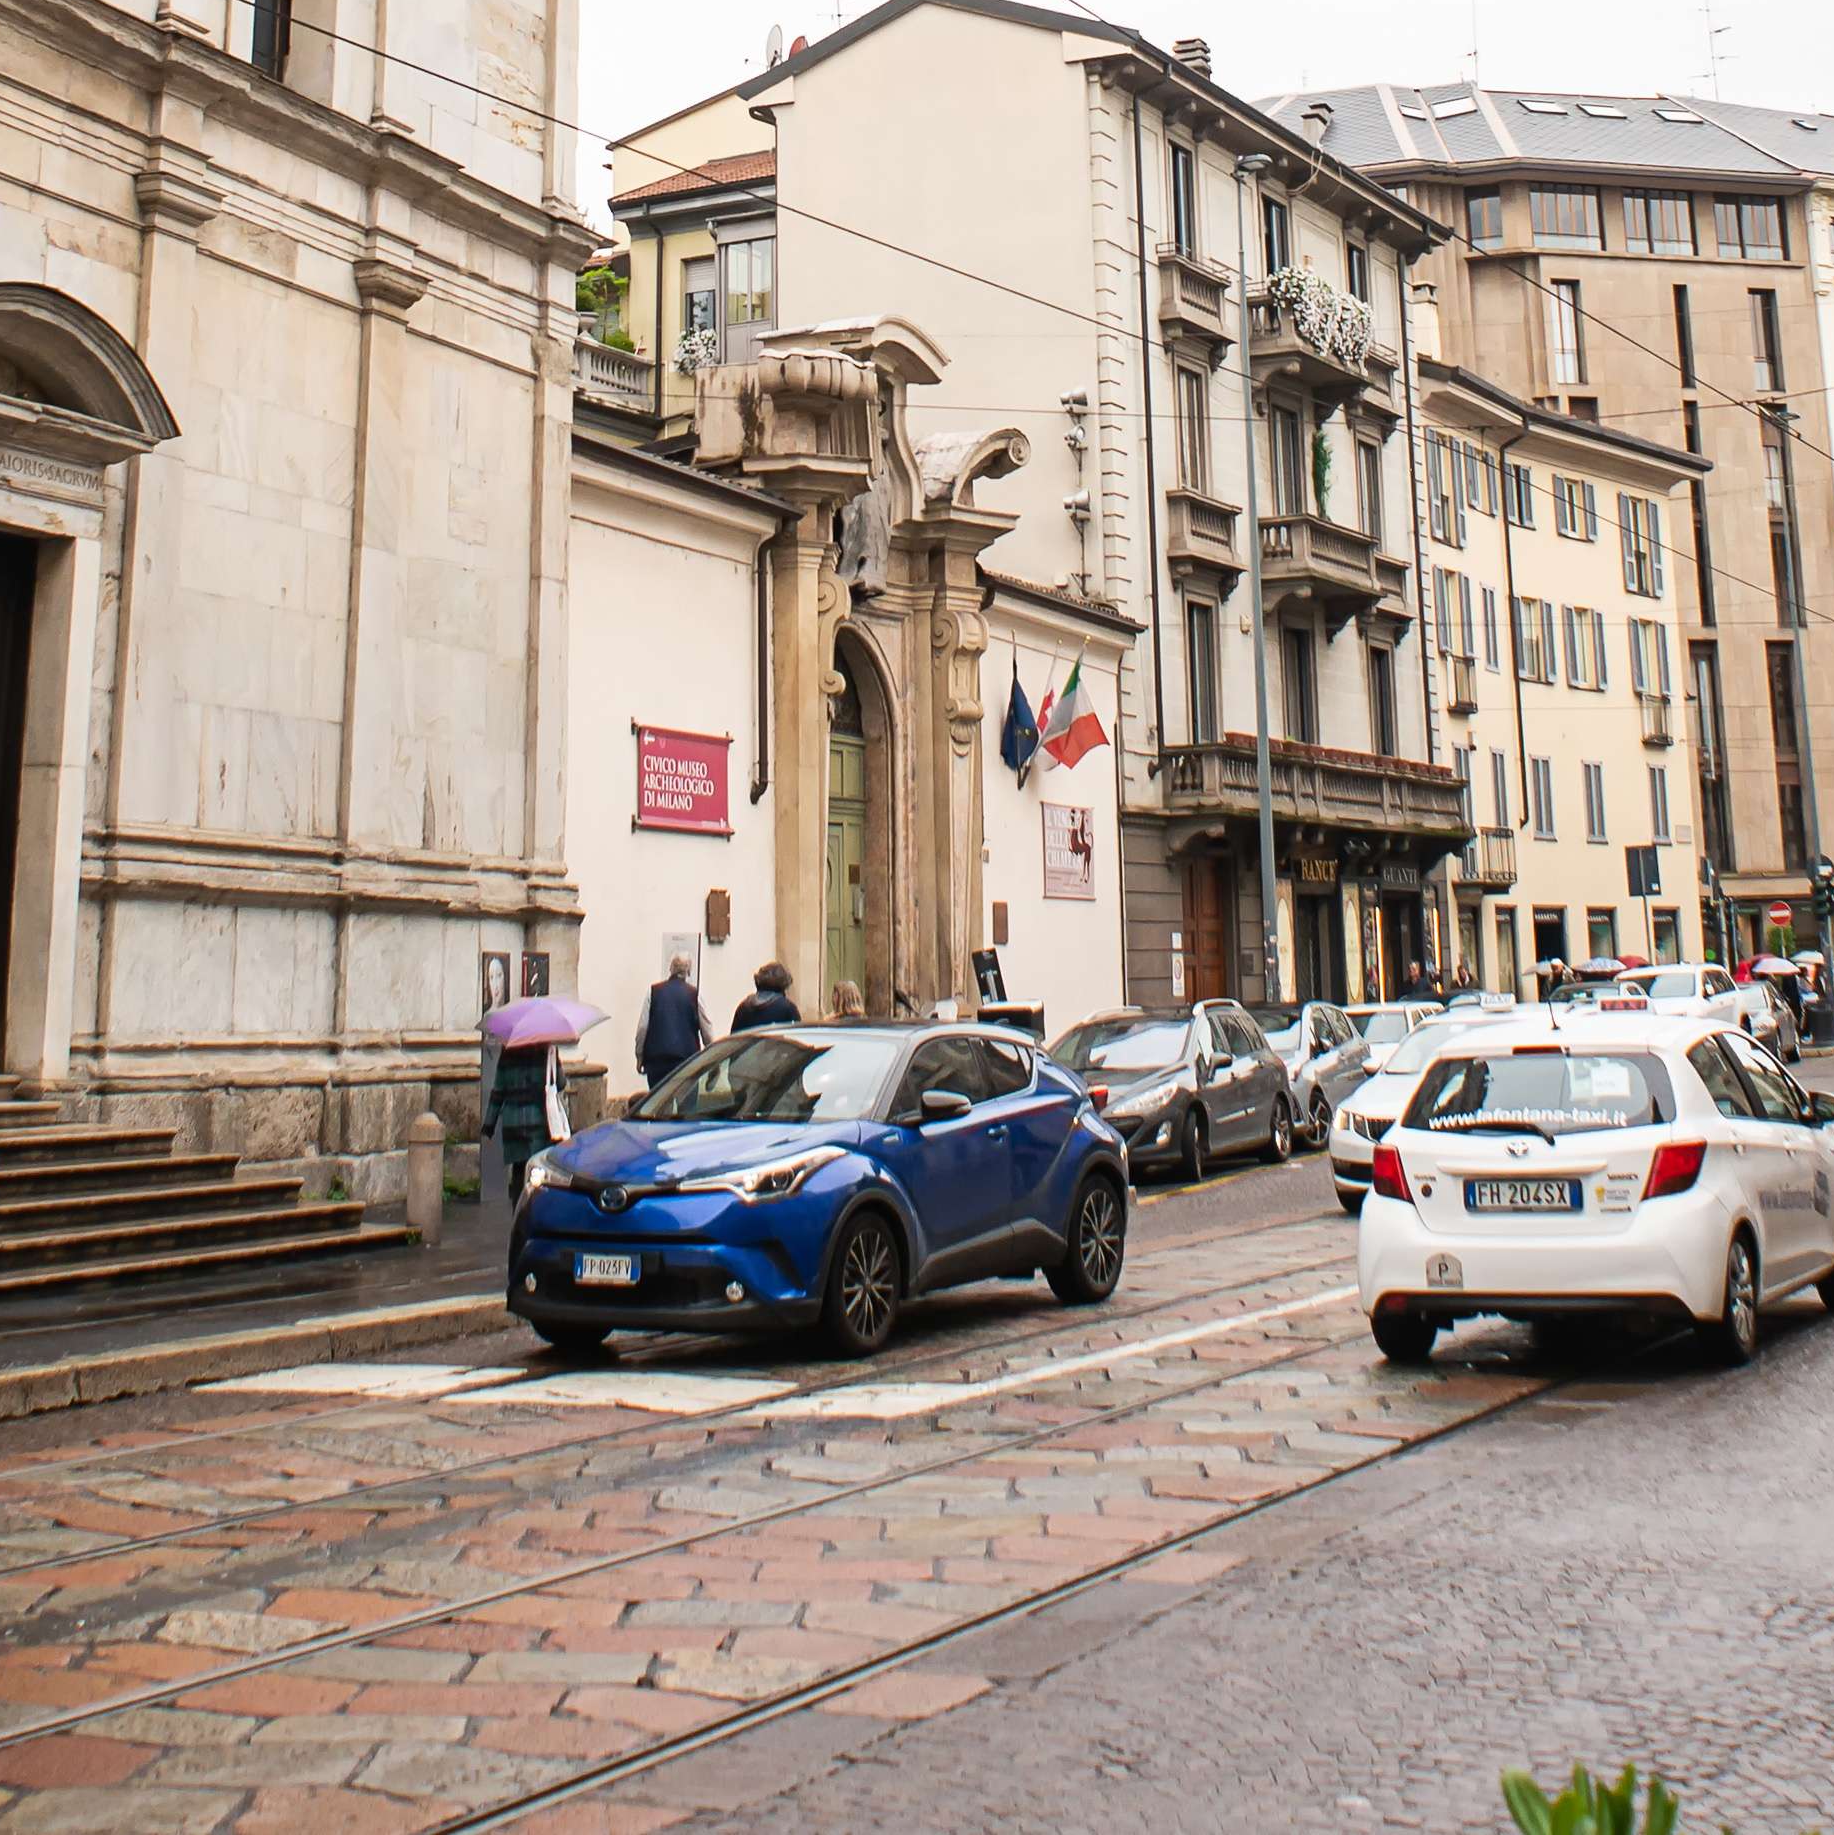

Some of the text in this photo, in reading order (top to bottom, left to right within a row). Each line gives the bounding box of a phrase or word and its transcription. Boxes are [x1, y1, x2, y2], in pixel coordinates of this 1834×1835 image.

[643, 755, 708, 779] CIVICO MUSEO
[643, 773, 715, 796] ARCHEOLOGICO
[644, 790, 693, 811] DI MILANO
[1383, 867, 1417, 885] GUANTI
[1478, 1181, 1567, 1205] FH 204SX
